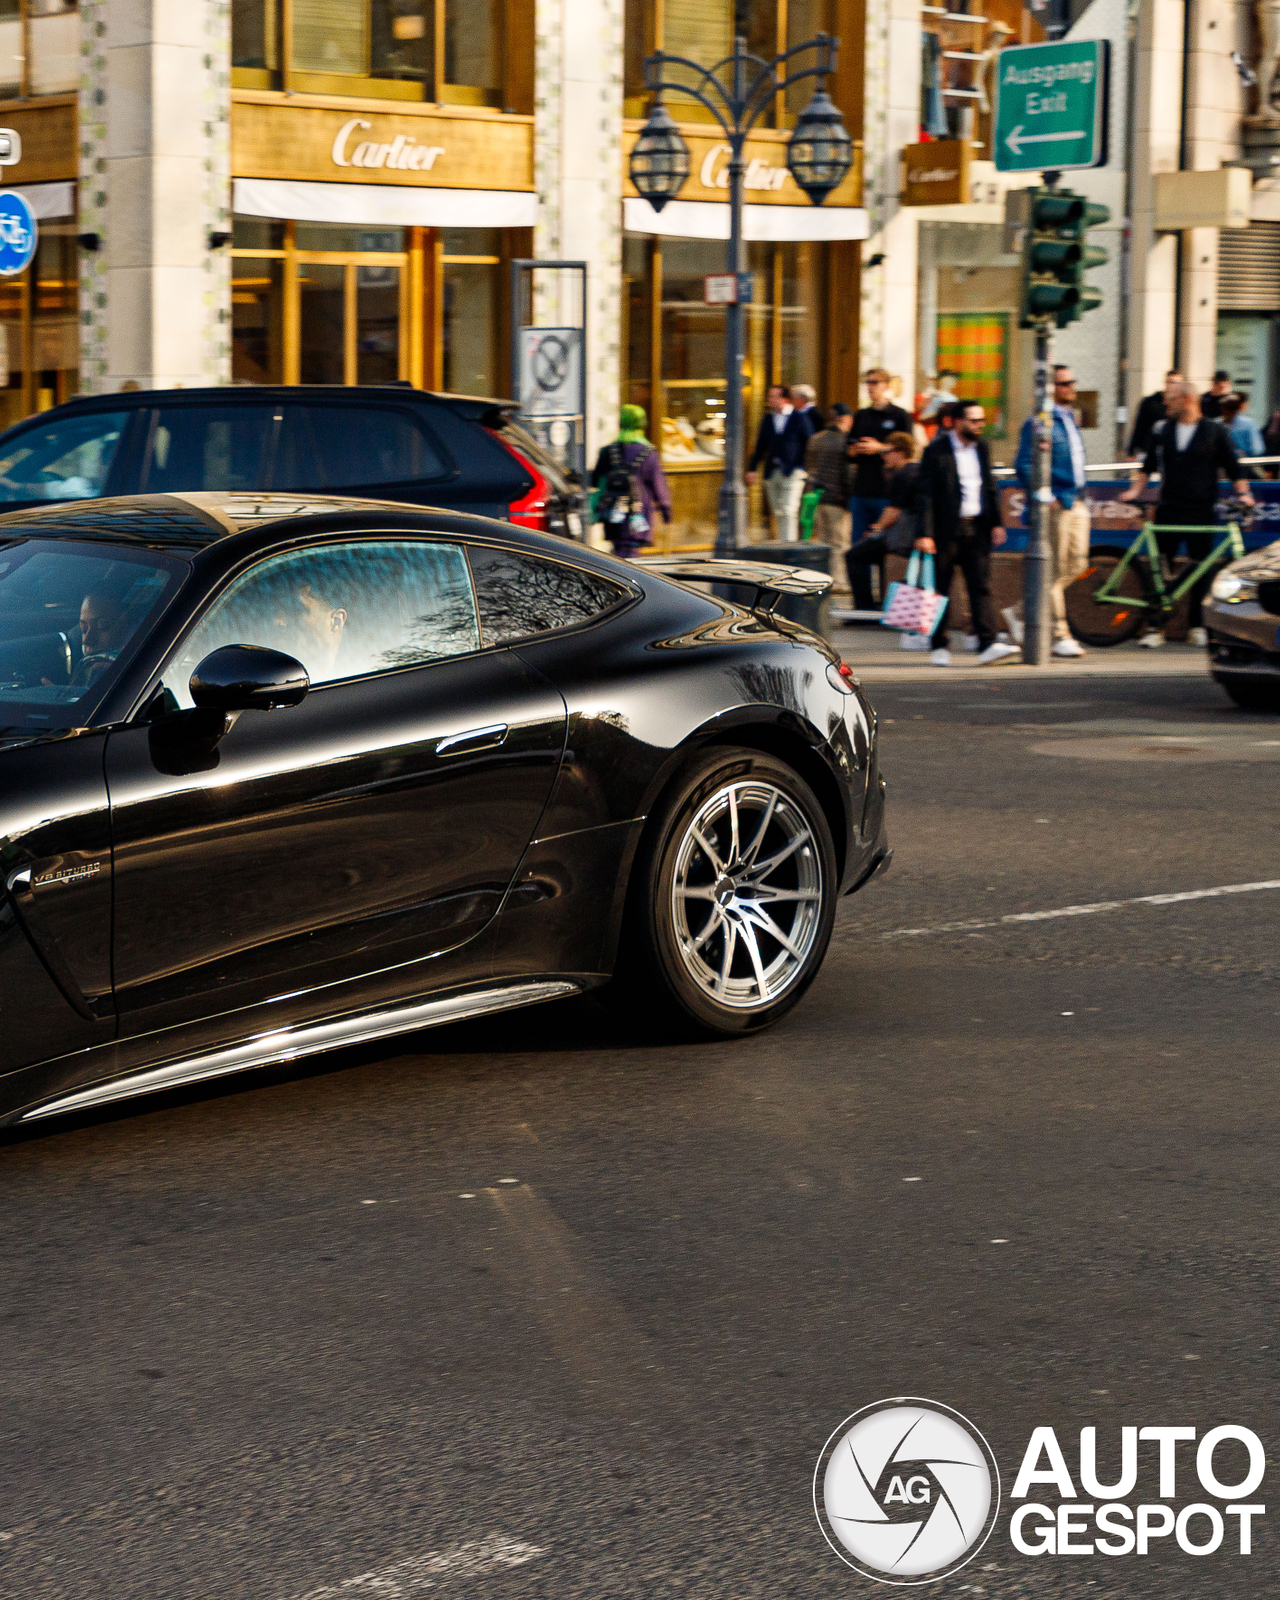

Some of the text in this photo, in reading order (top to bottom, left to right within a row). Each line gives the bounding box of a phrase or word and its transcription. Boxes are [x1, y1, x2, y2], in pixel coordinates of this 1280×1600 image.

[1003, 61, 1094, 88] Ausgang
[1025, 92, 1068, 115] Exit
[332, 118, 446, 170] Cartier
